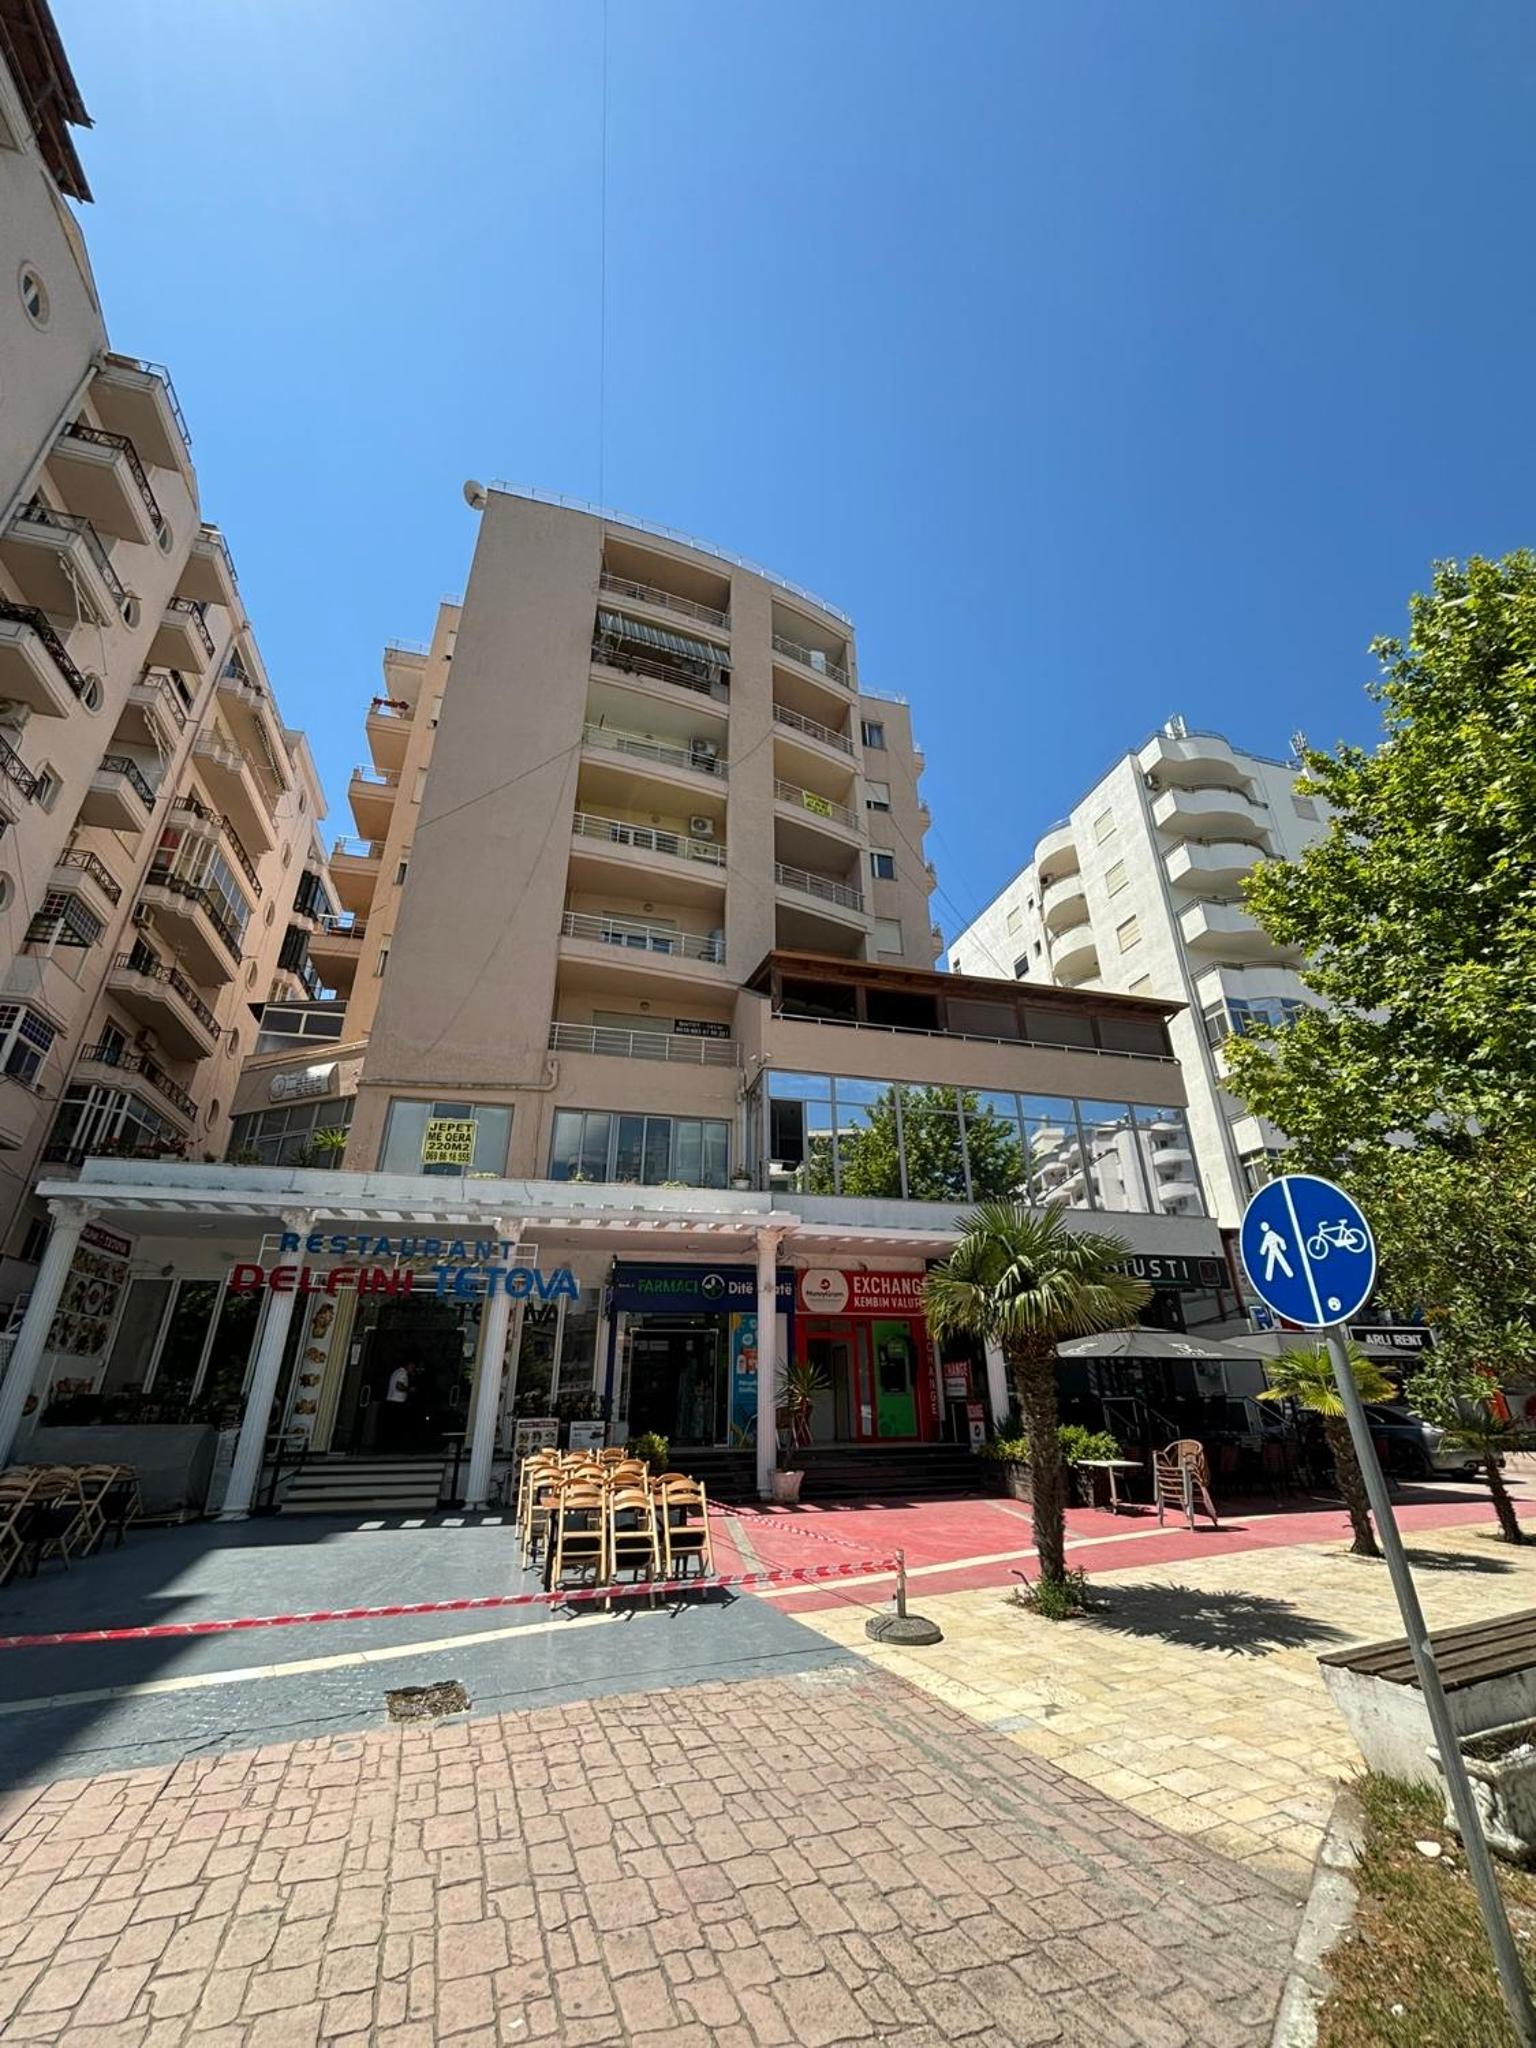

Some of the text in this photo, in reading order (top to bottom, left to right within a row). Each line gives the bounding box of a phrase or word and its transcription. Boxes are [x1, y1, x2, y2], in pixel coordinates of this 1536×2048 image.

[429, 1122, 473, 1132] JEPET
[428, 1132, 442, 1141] ME
[428, 1142, 470, 1151] 220M2
[279, 1232, 515, 1259] RESTAURANT
[229, 1264, 579, 1300] DELFINI TETOVA
[638, 1279, 699, 1294] FARMACI
[728, 1281, 753, 1295] Ditë
[854, 1297, 890, 1307] KEMBIM
[1365, 1334, 1422, 1346] ARLI RENT
